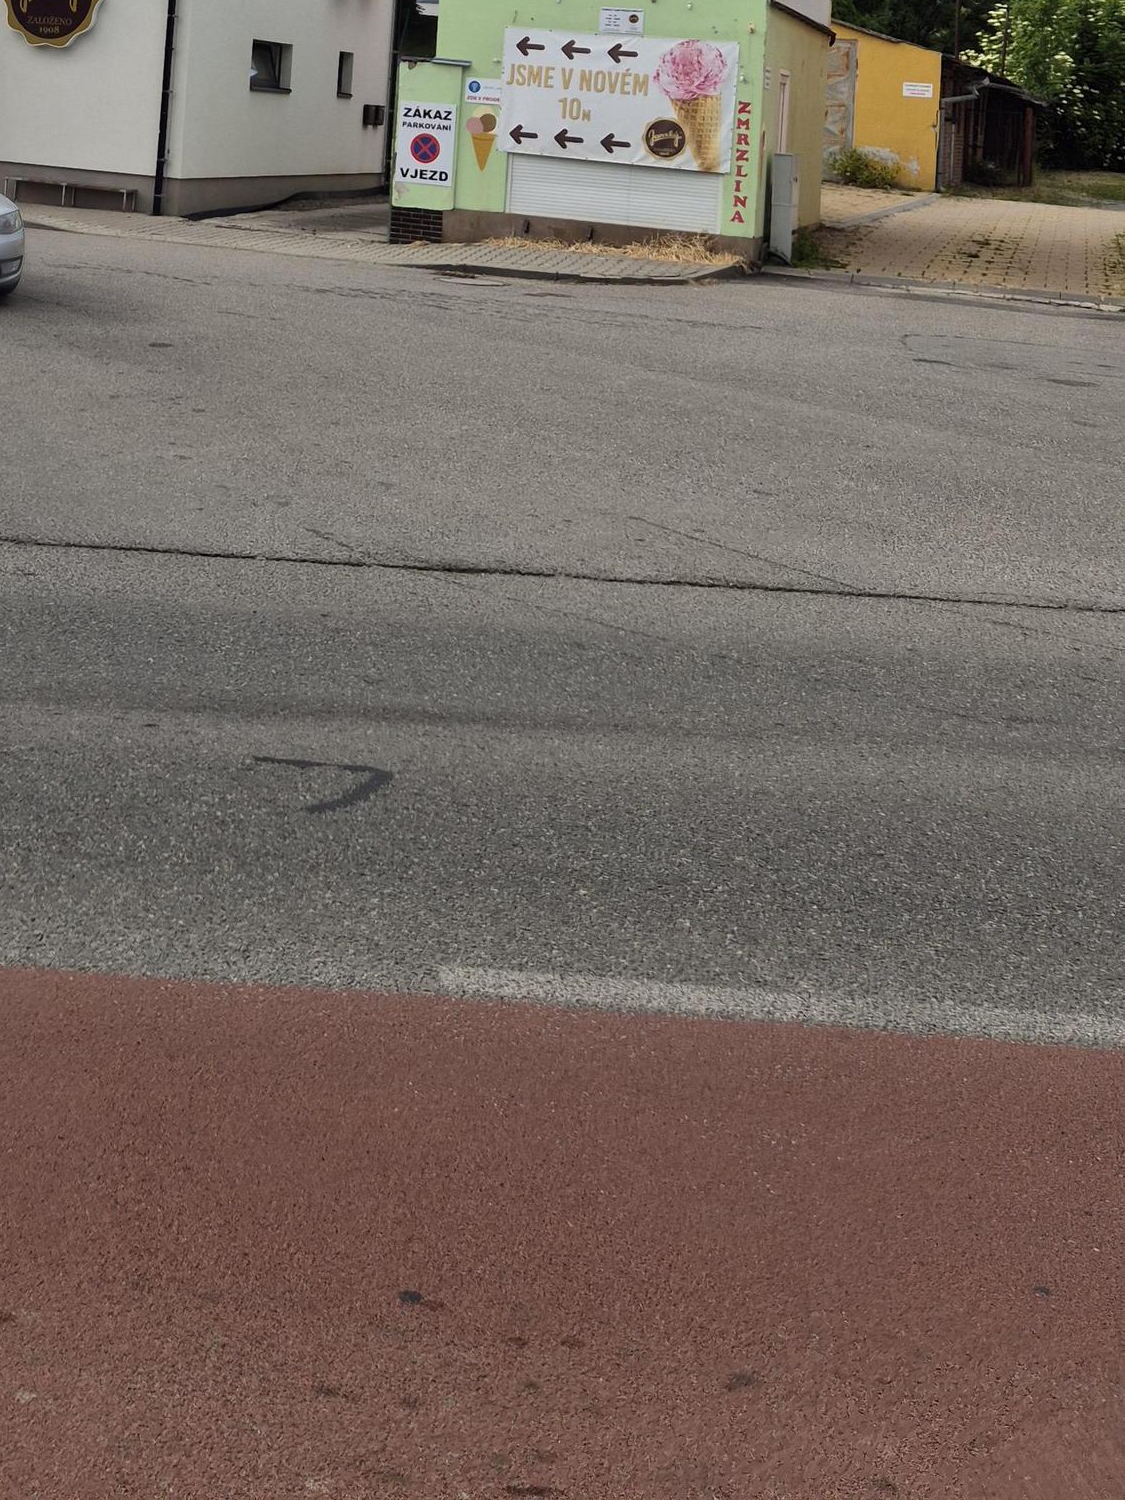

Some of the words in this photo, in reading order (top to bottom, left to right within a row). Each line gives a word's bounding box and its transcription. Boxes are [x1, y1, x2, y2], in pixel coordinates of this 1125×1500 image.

[506, 63, 555, 88] JSME
[561, 67, 574, 90] V
[579, 68, 649, 97] NOVÉM
[403, 106, 452, 121] ZÁKAZ
[730, 100, 752, 223] ZMRZLINA
[400, 167, 449, 182] VJEZD
